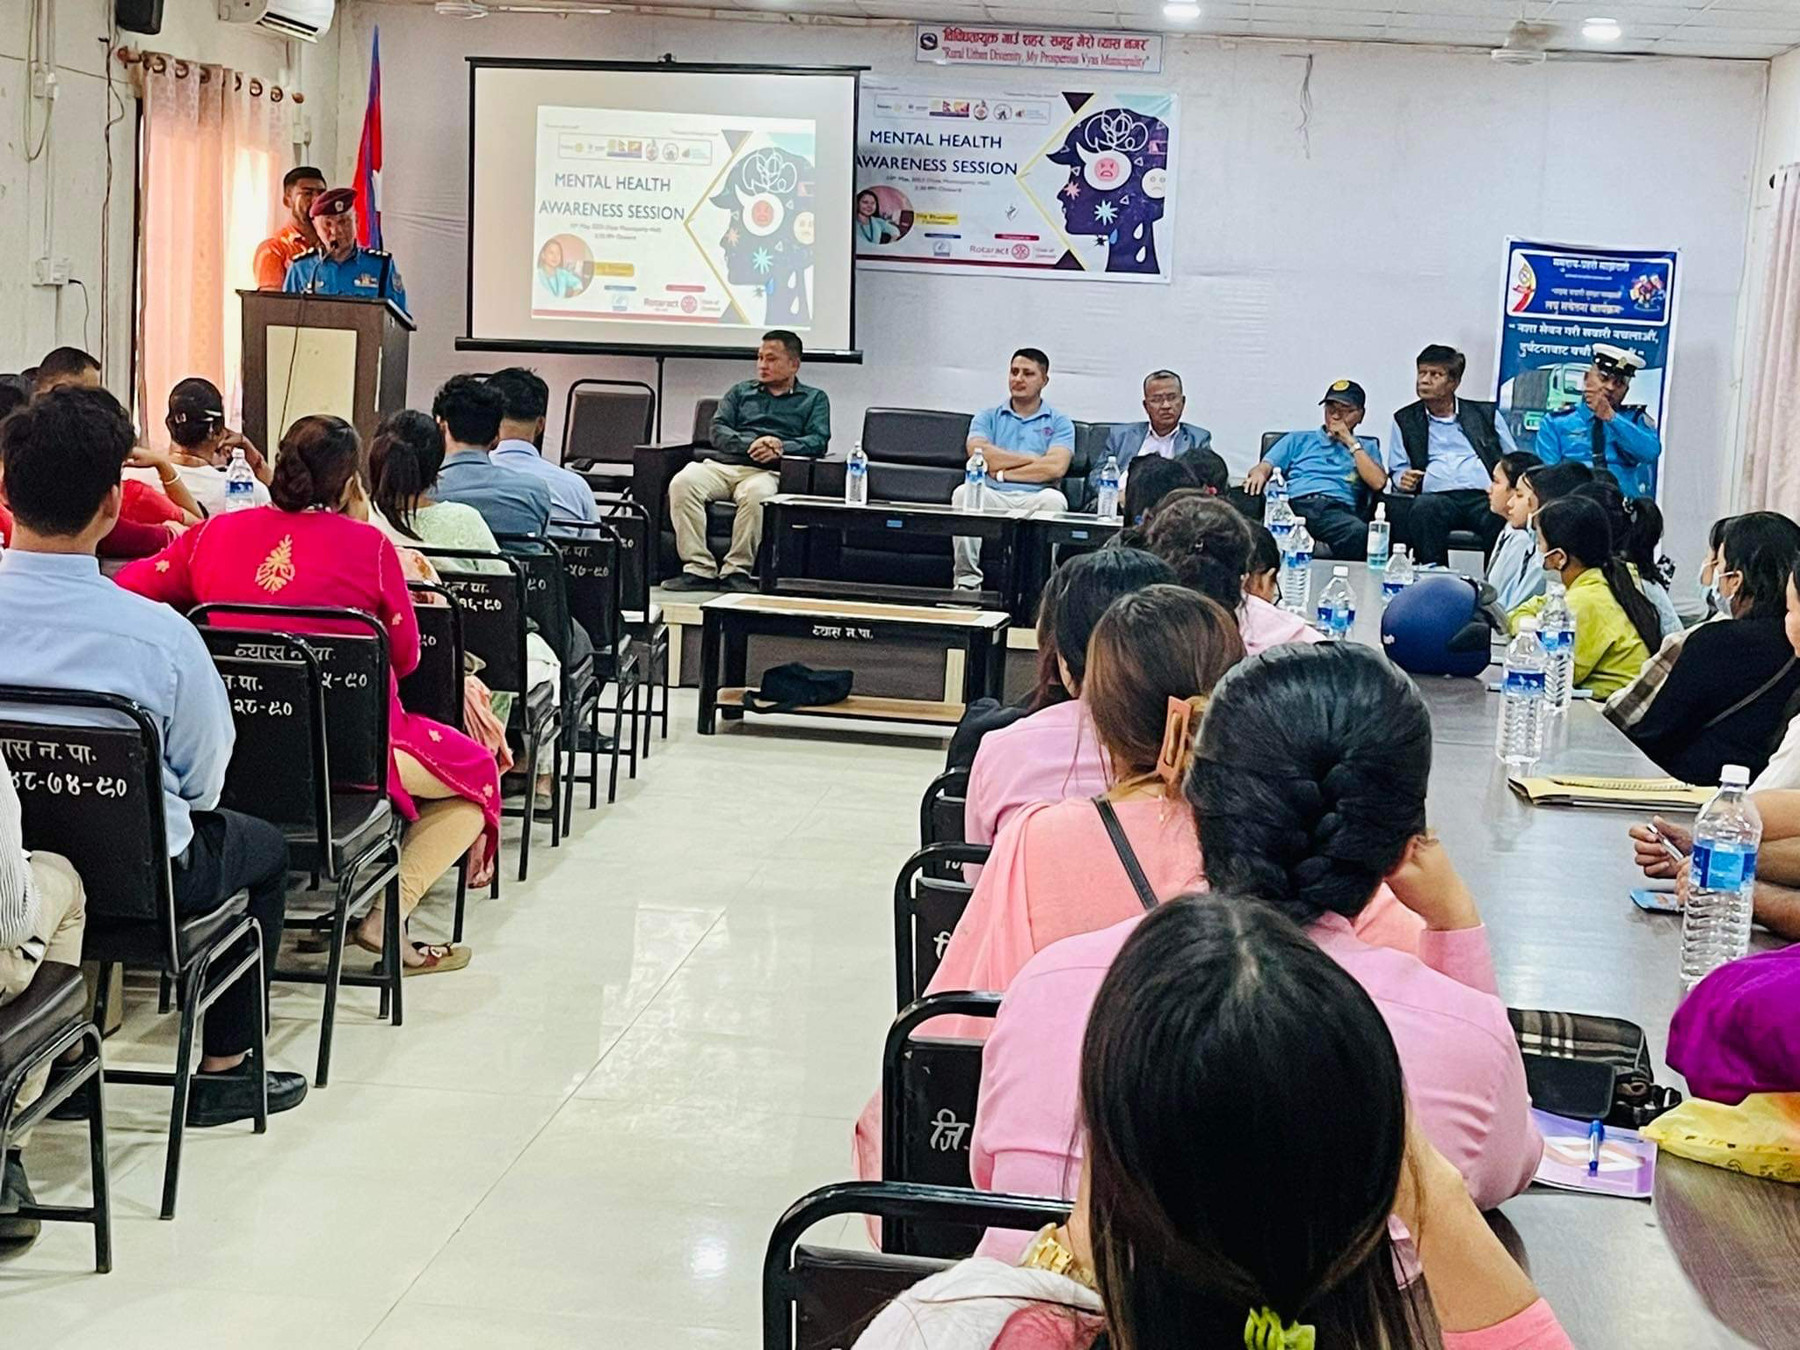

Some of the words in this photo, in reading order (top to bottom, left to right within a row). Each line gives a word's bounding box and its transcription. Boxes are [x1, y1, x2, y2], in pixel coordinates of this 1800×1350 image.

[870, 130, 934, 146] MENTAL
[939, 133, 1002, 149] HEALTH
[952, 159, 1018, 176] SESSION
[554, 173, 612, 189] MENTAL
[616, 176, 671, 192] HEALTH
[539, 200, 623, 218] AWARENESS
[627, 204, 685, 220] SESSION
[969, 245, 1009, 255] Rotaract
[812, 624, 842, 639] व्यास
[234, 643, 287, 661] व्यास
